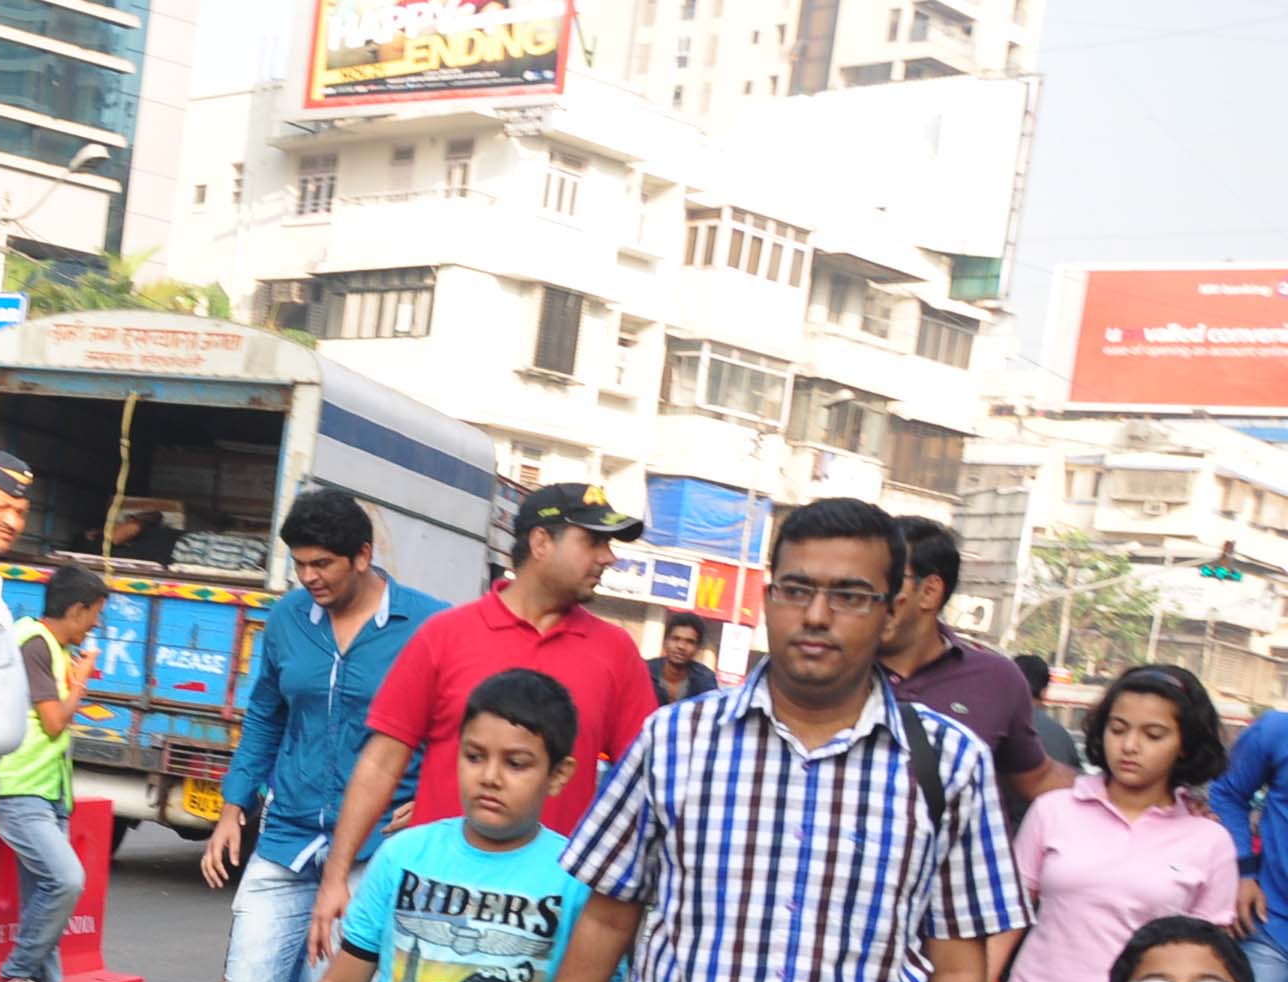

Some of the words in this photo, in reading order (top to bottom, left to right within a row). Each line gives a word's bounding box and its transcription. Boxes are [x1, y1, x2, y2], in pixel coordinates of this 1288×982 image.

[403, 17, 558, 70] ENDING
[156, 645, 227, 676] PLEASE
[395, 867, 563, 938] RIDERS
